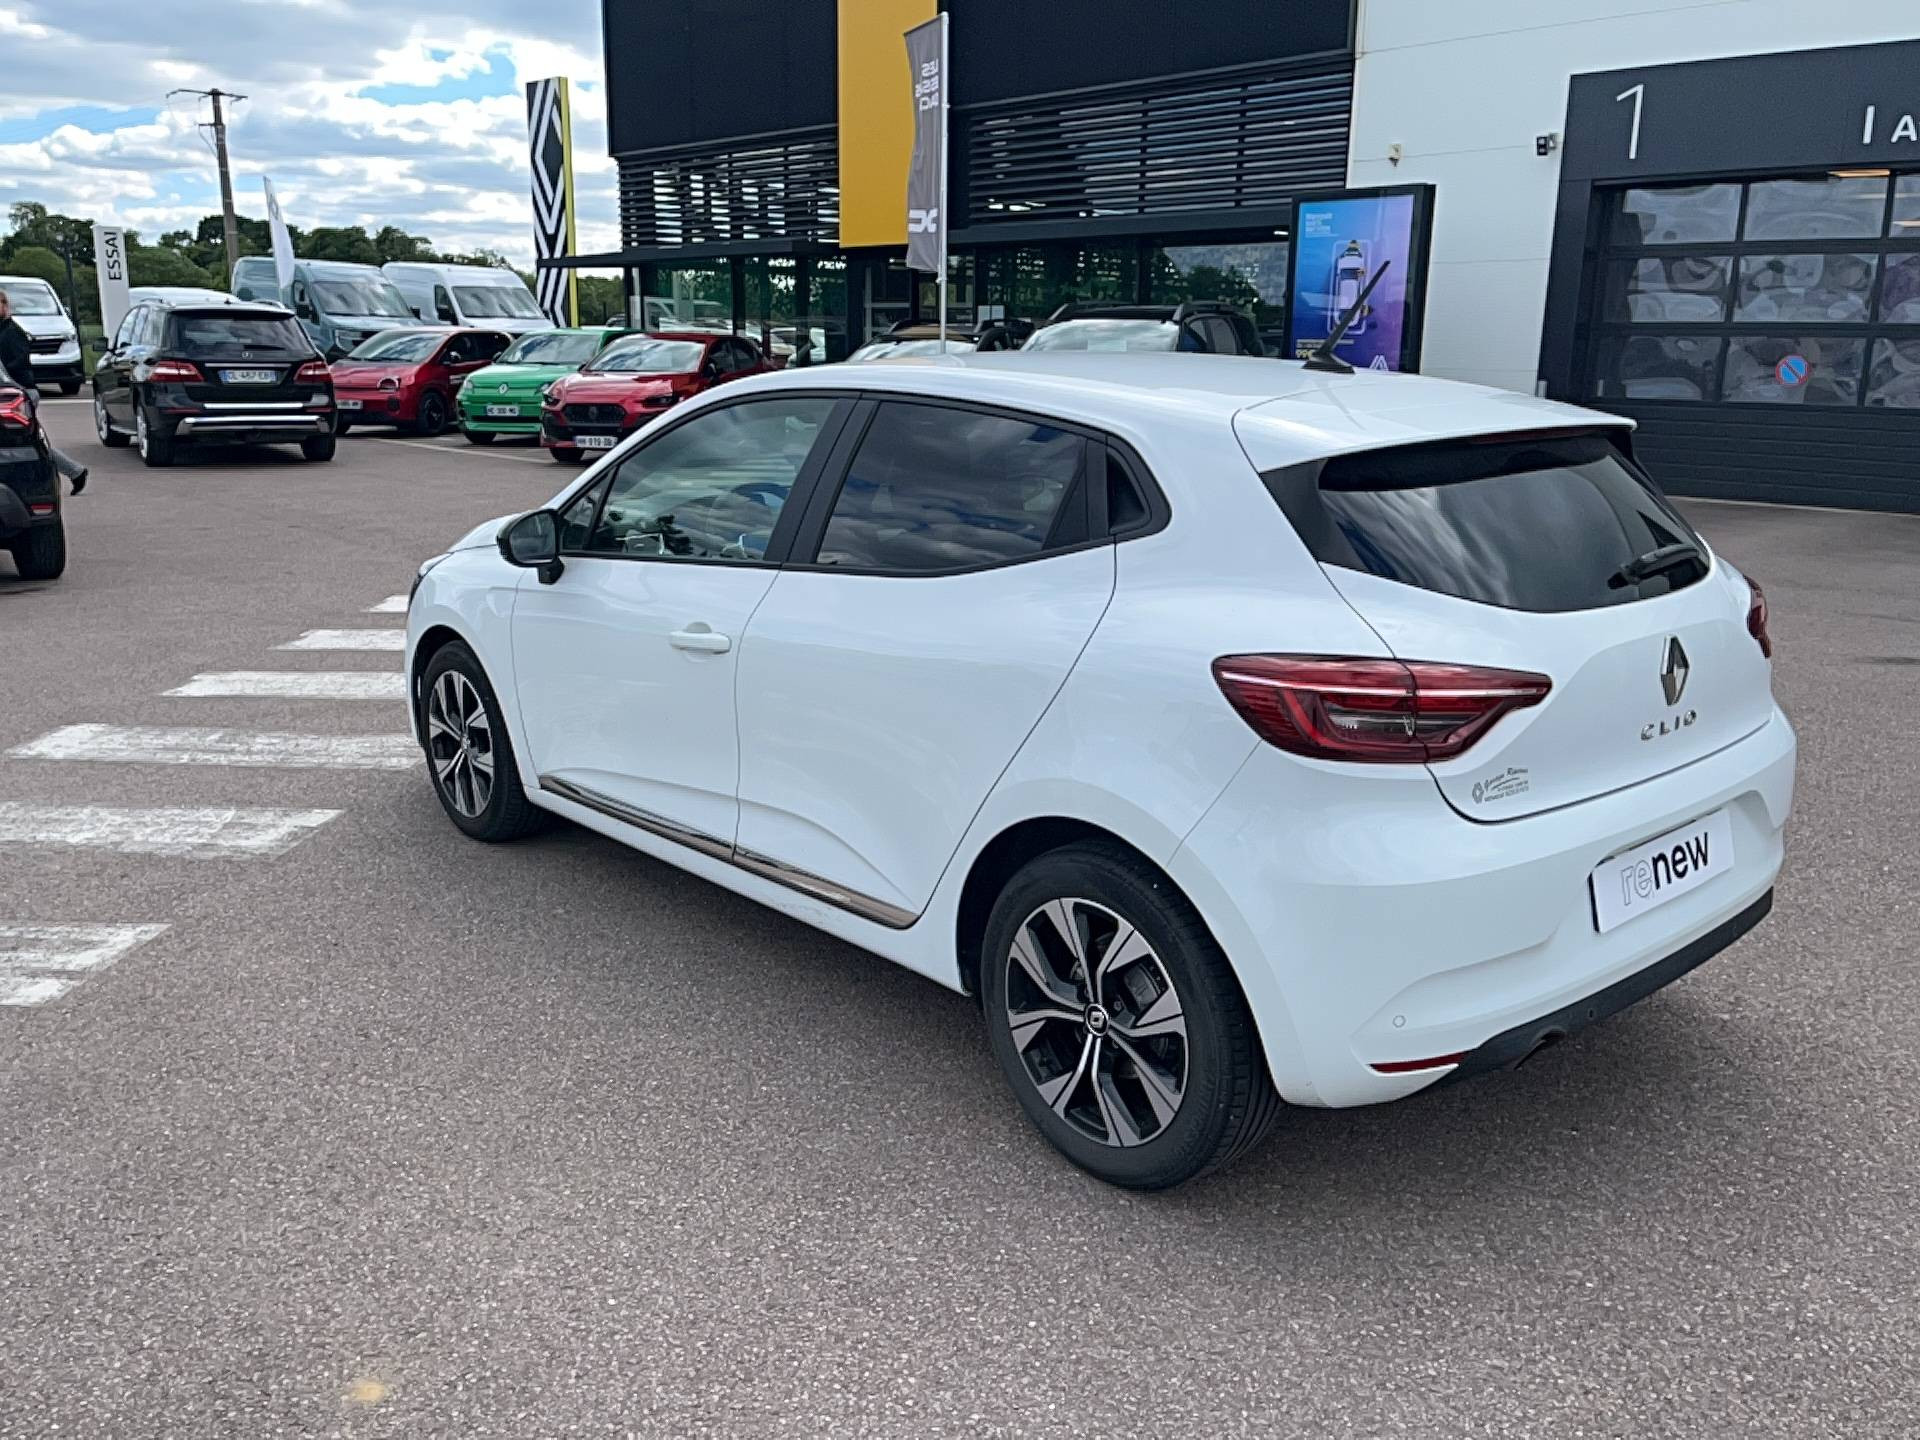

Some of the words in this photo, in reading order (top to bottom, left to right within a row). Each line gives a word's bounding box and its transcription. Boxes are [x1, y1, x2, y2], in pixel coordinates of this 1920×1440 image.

[1616, 83, 1644, 160] 1
[103, 231, 122, 281] ESSAI
[1640, 709, 1697, 741] CLIO
[1620, 832, 1709, 906] renew
